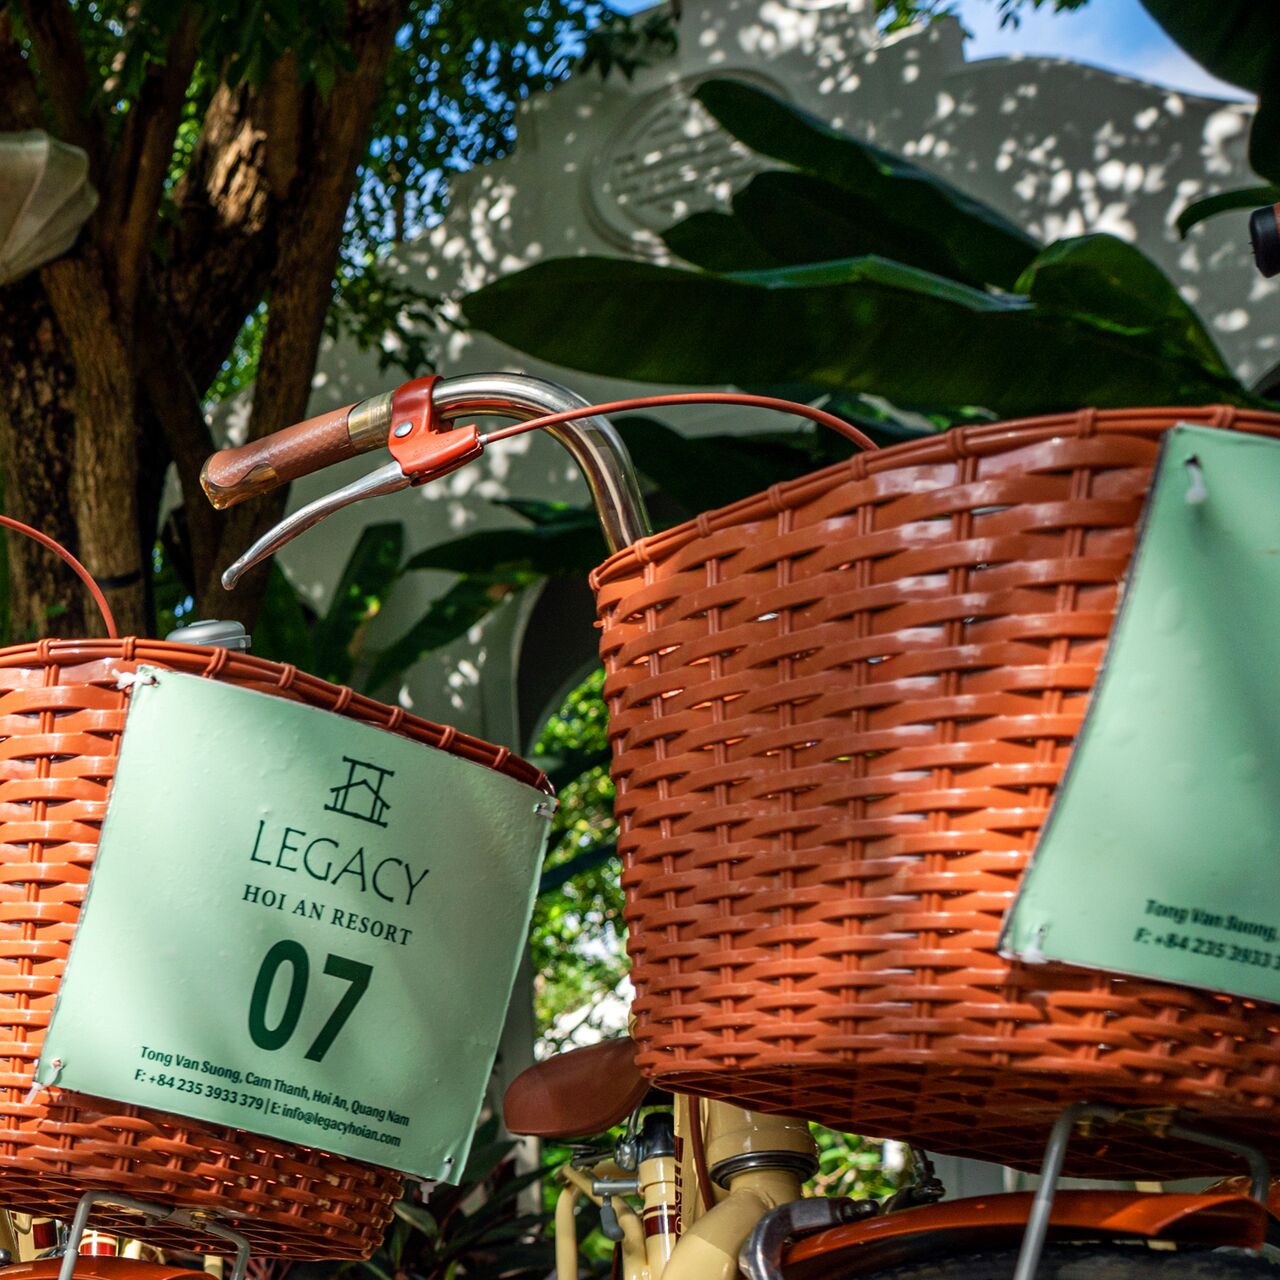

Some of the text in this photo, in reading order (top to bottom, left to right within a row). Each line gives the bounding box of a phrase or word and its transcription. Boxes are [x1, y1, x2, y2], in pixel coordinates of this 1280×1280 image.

[249, 819, 430, 906] LEGACY
[241, 883, 413, 946] HOI AN RESORT
[1145, 899, 1189, 925] Tong
[1191, 907, 1223, 928] Van
[1154, 932, 1189, 949] +84
[1190, 937, 1225, 959] 235
[247, 939, 374, 1063] 07
[134, 1068, 147, 1083] F:
[148, 1073, 176, 1089] +84
[176, 1078, 204, 1095] 235
[204, 1084, 239, 1104] 3933
[238, 1093, 264, 1110] 379
[269, 1101, 282, 1115] E:
[281, 1103, 402, 1147] info@legacyhoian.com
[140, 1045, 410, 1127] Tong Van Suong, Cam Thanh, Hoi An, Quang Nam
